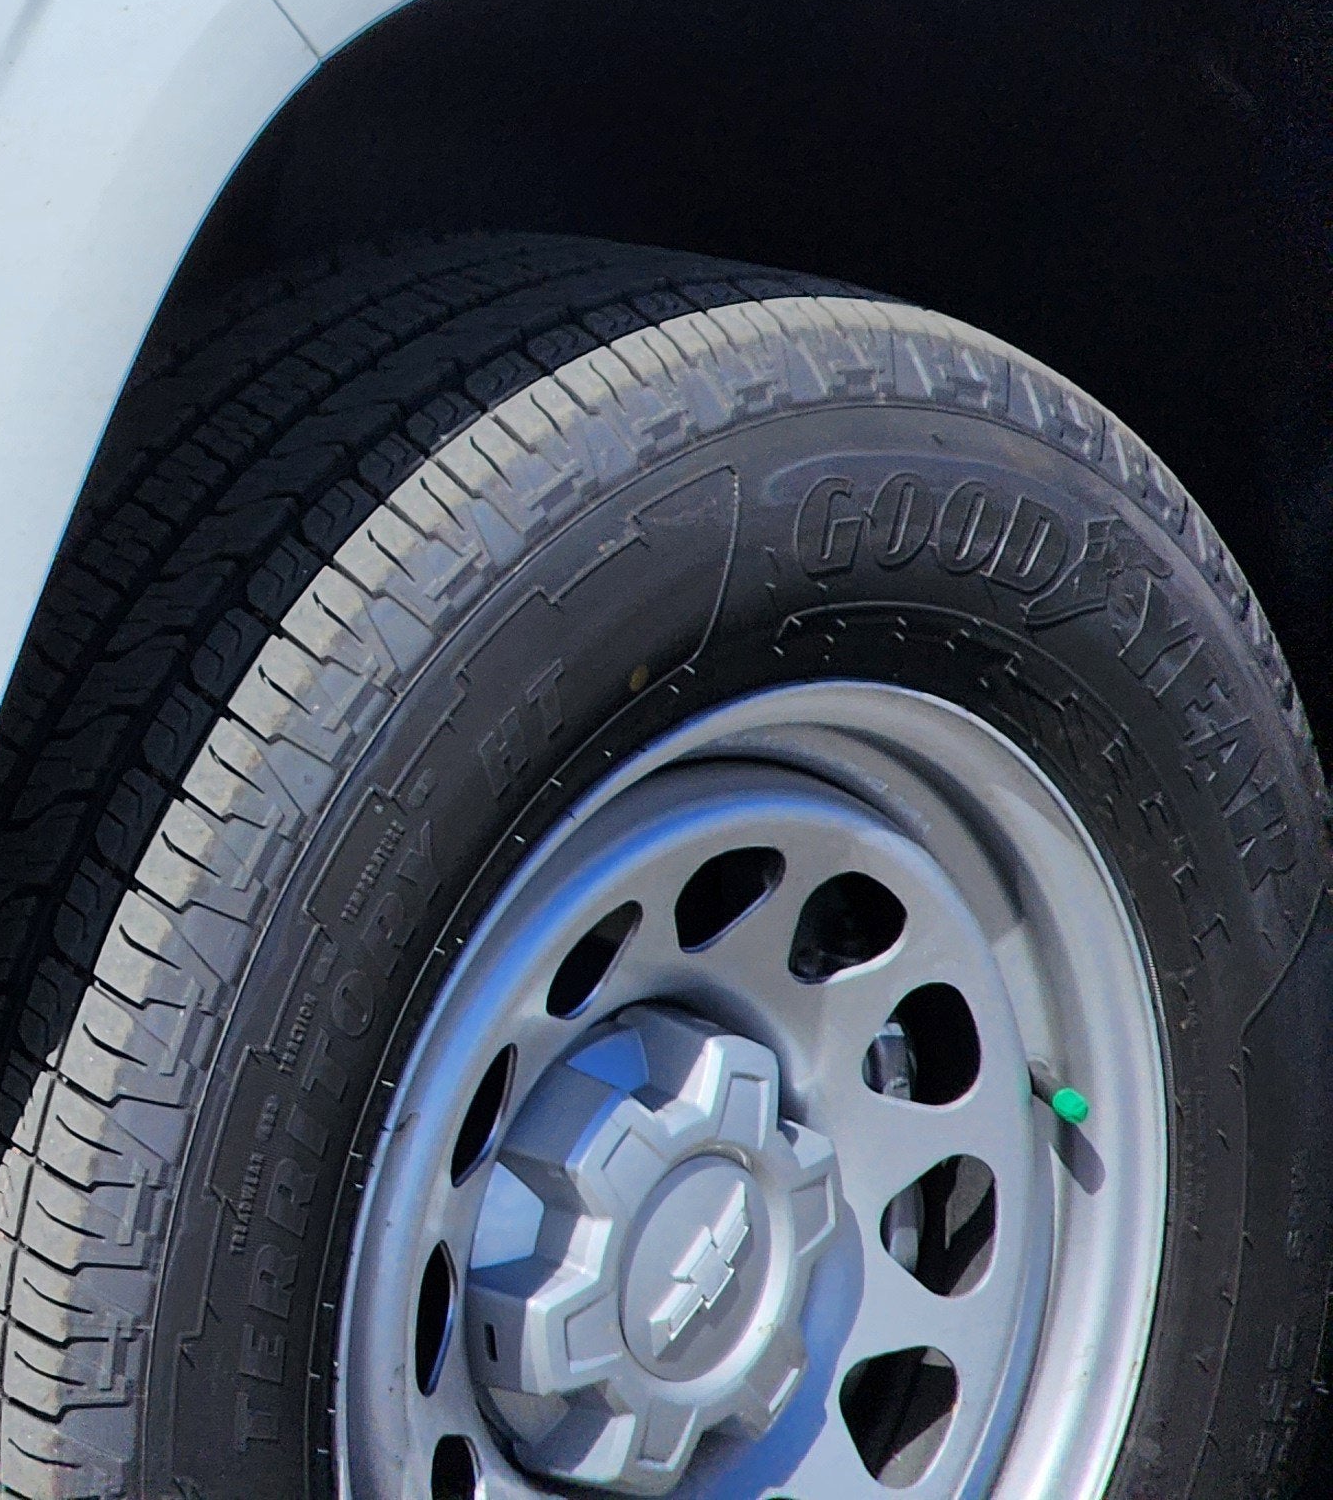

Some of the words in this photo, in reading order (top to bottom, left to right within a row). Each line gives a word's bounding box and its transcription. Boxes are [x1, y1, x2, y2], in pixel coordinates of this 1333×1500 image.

[793, 471, 1299, 898] GOODYEAR
[230, 1150, 267, 1255] TREADWEAR
[235, 819, 442, 1452] TERRITORY
[478, 656, 565, 800] HT
